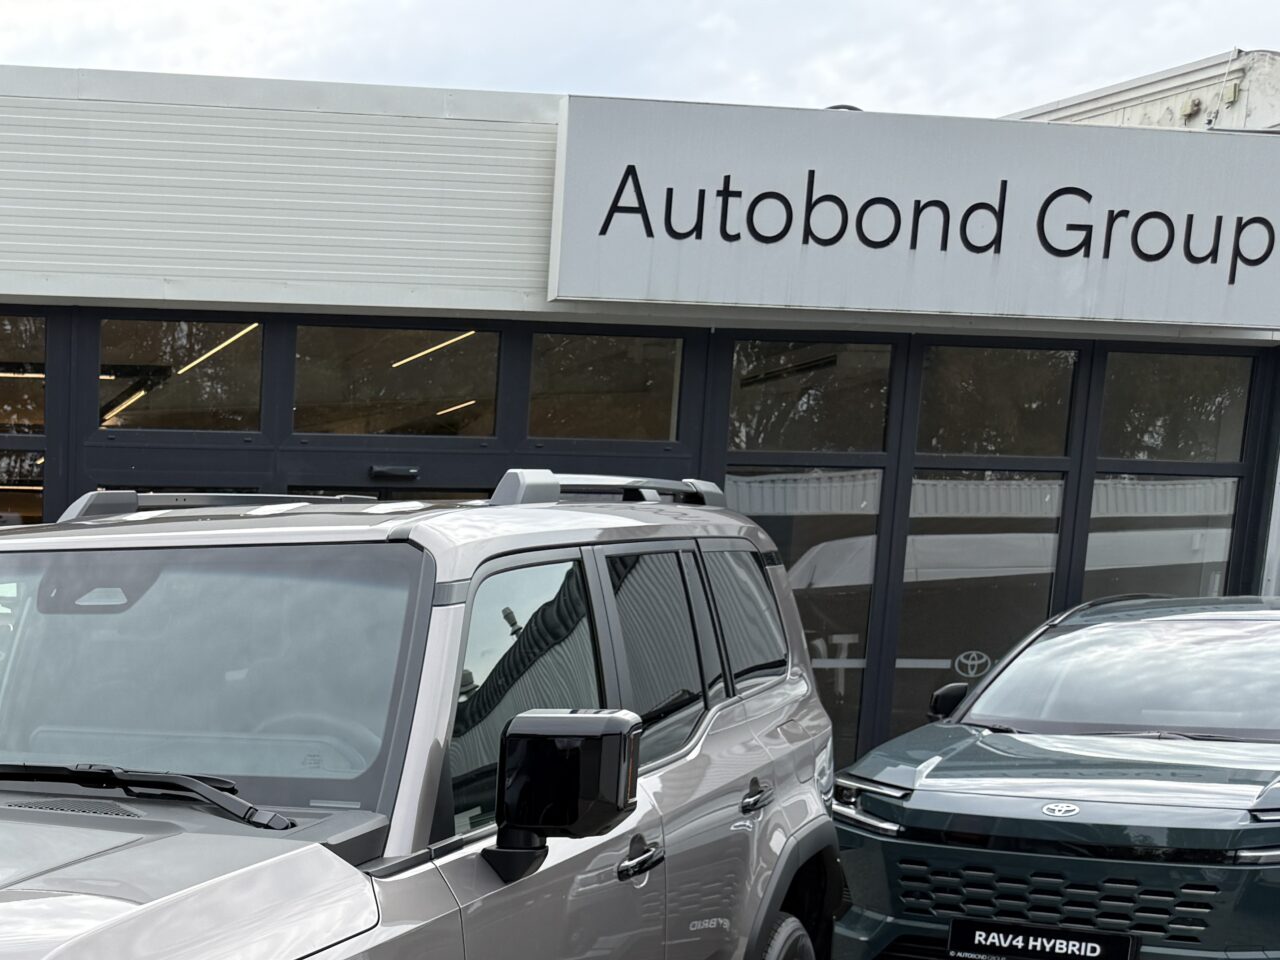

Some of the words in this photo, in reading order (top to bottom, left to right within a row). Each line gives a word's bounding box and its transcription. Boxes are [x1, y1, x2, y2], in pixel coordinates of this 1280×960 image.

[599, 164, 1008, 255] Autobond
[1036, 186, 1276, 286] Group
[955, 952, 987, 960] AUTOBOND
[974, 930, 1025, 949] RAV4
[1028, 937, 1101, 958] HYBRID
